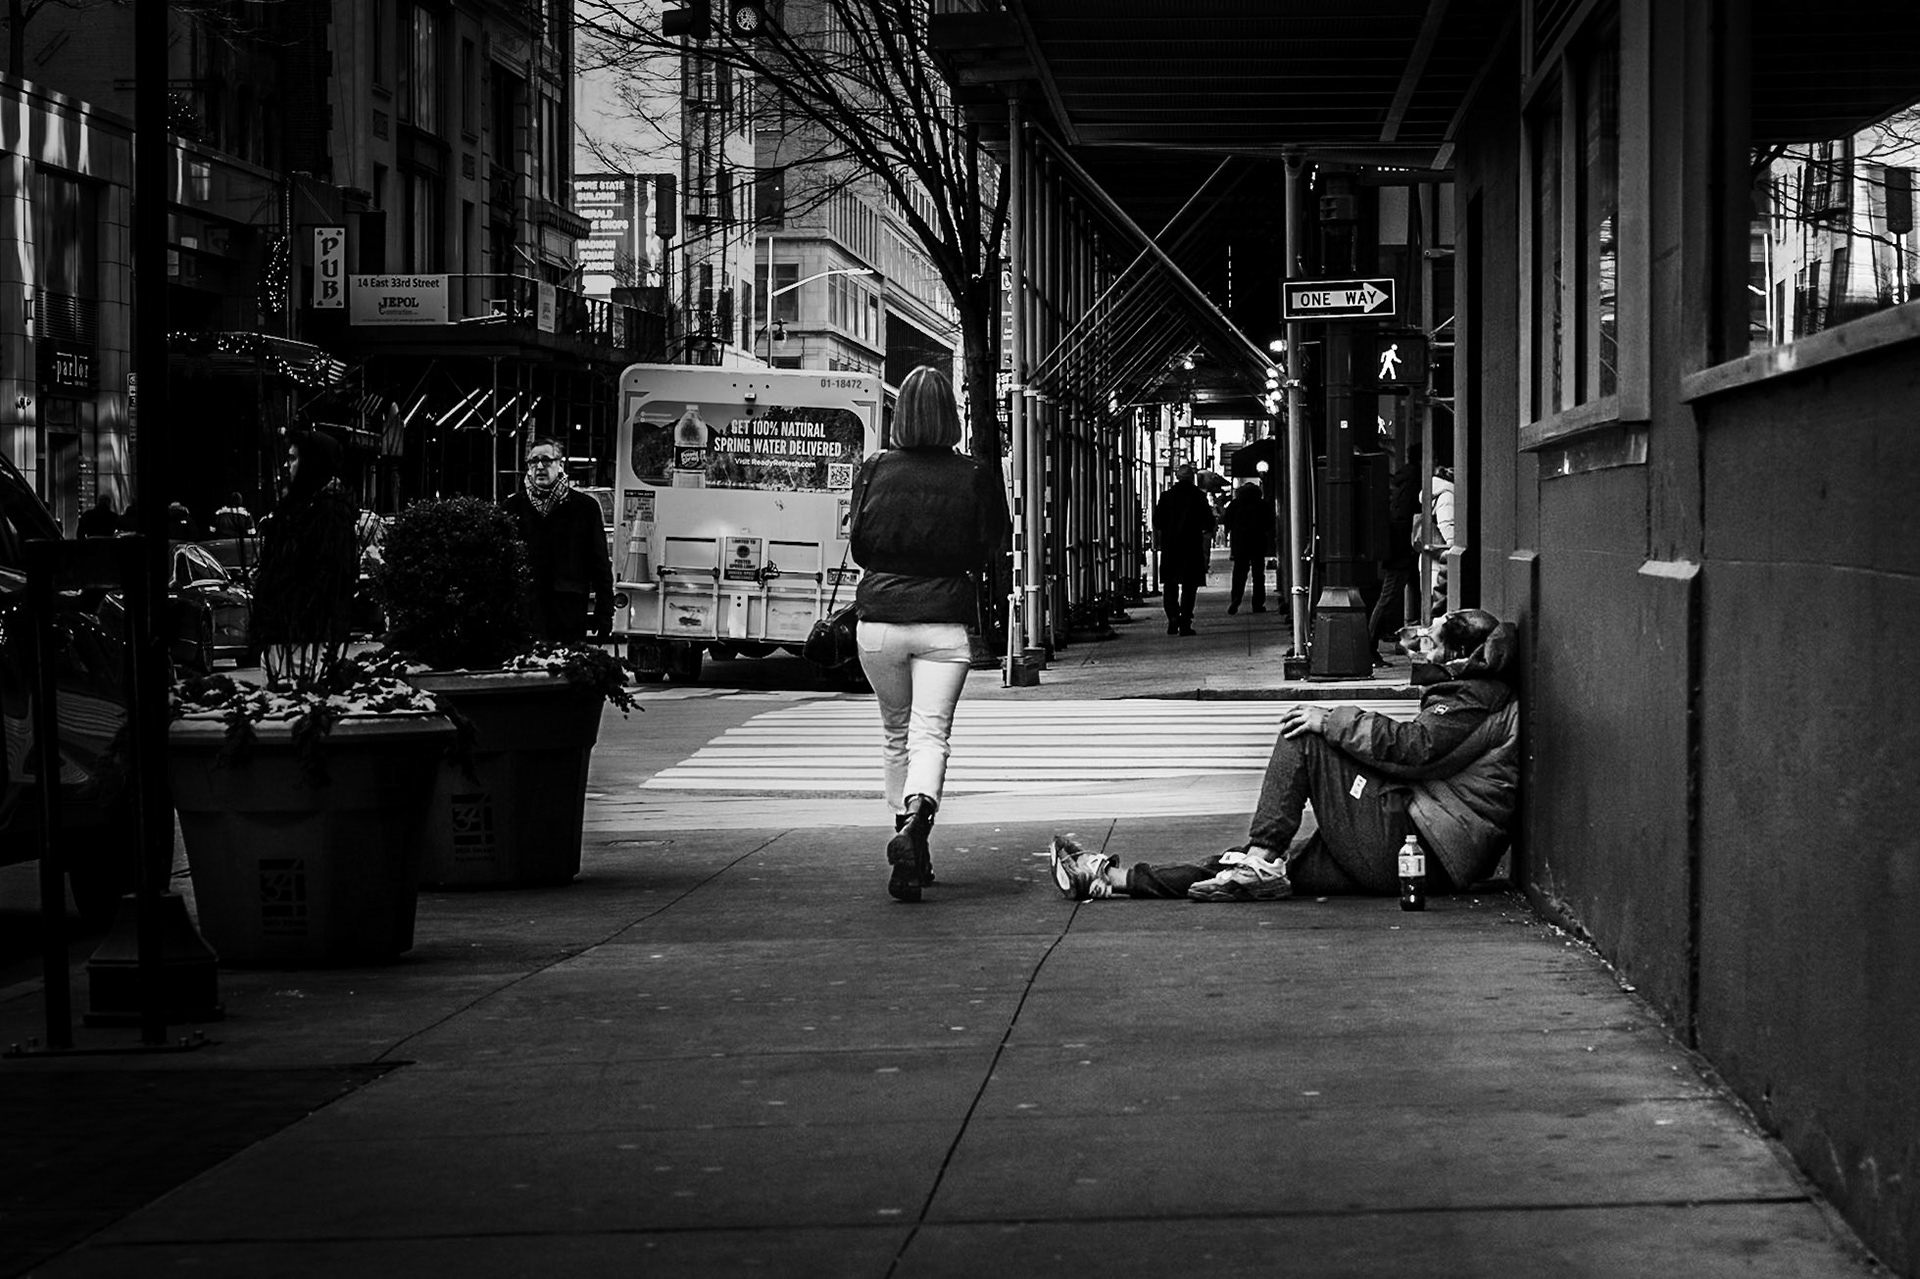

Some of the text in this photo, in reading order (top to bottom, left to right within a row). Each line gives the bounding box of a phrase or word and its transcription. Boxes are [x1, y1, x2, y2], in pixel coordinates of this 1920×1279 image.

[599, 181, 625, 190] STATE
[577, 192, 616, 201] BUILDING
[579, 209, 614, 219] HERALD
[600, 220, 629, 230] SHOPS
[578, 239, 616, 250] MADISON
[579, 250, 615, 260] SQUARE
[320, 237, 340, 300] PUB
[581, 261, 615, 271] ARDEN
[358, 278, 440, 288] 14 East 33rd Street
[378, 297, 420, 308] JEPOL
[1300, 290, 1377, 307] ONE WAY
[56, 355, 89, 383] parlor
[820, 378, 862, 389] 01-18472
[731, 419, 826, 438] GET 100% NATURAL
[714, 436, 842, 457] SPRING WATER DELIVERED
